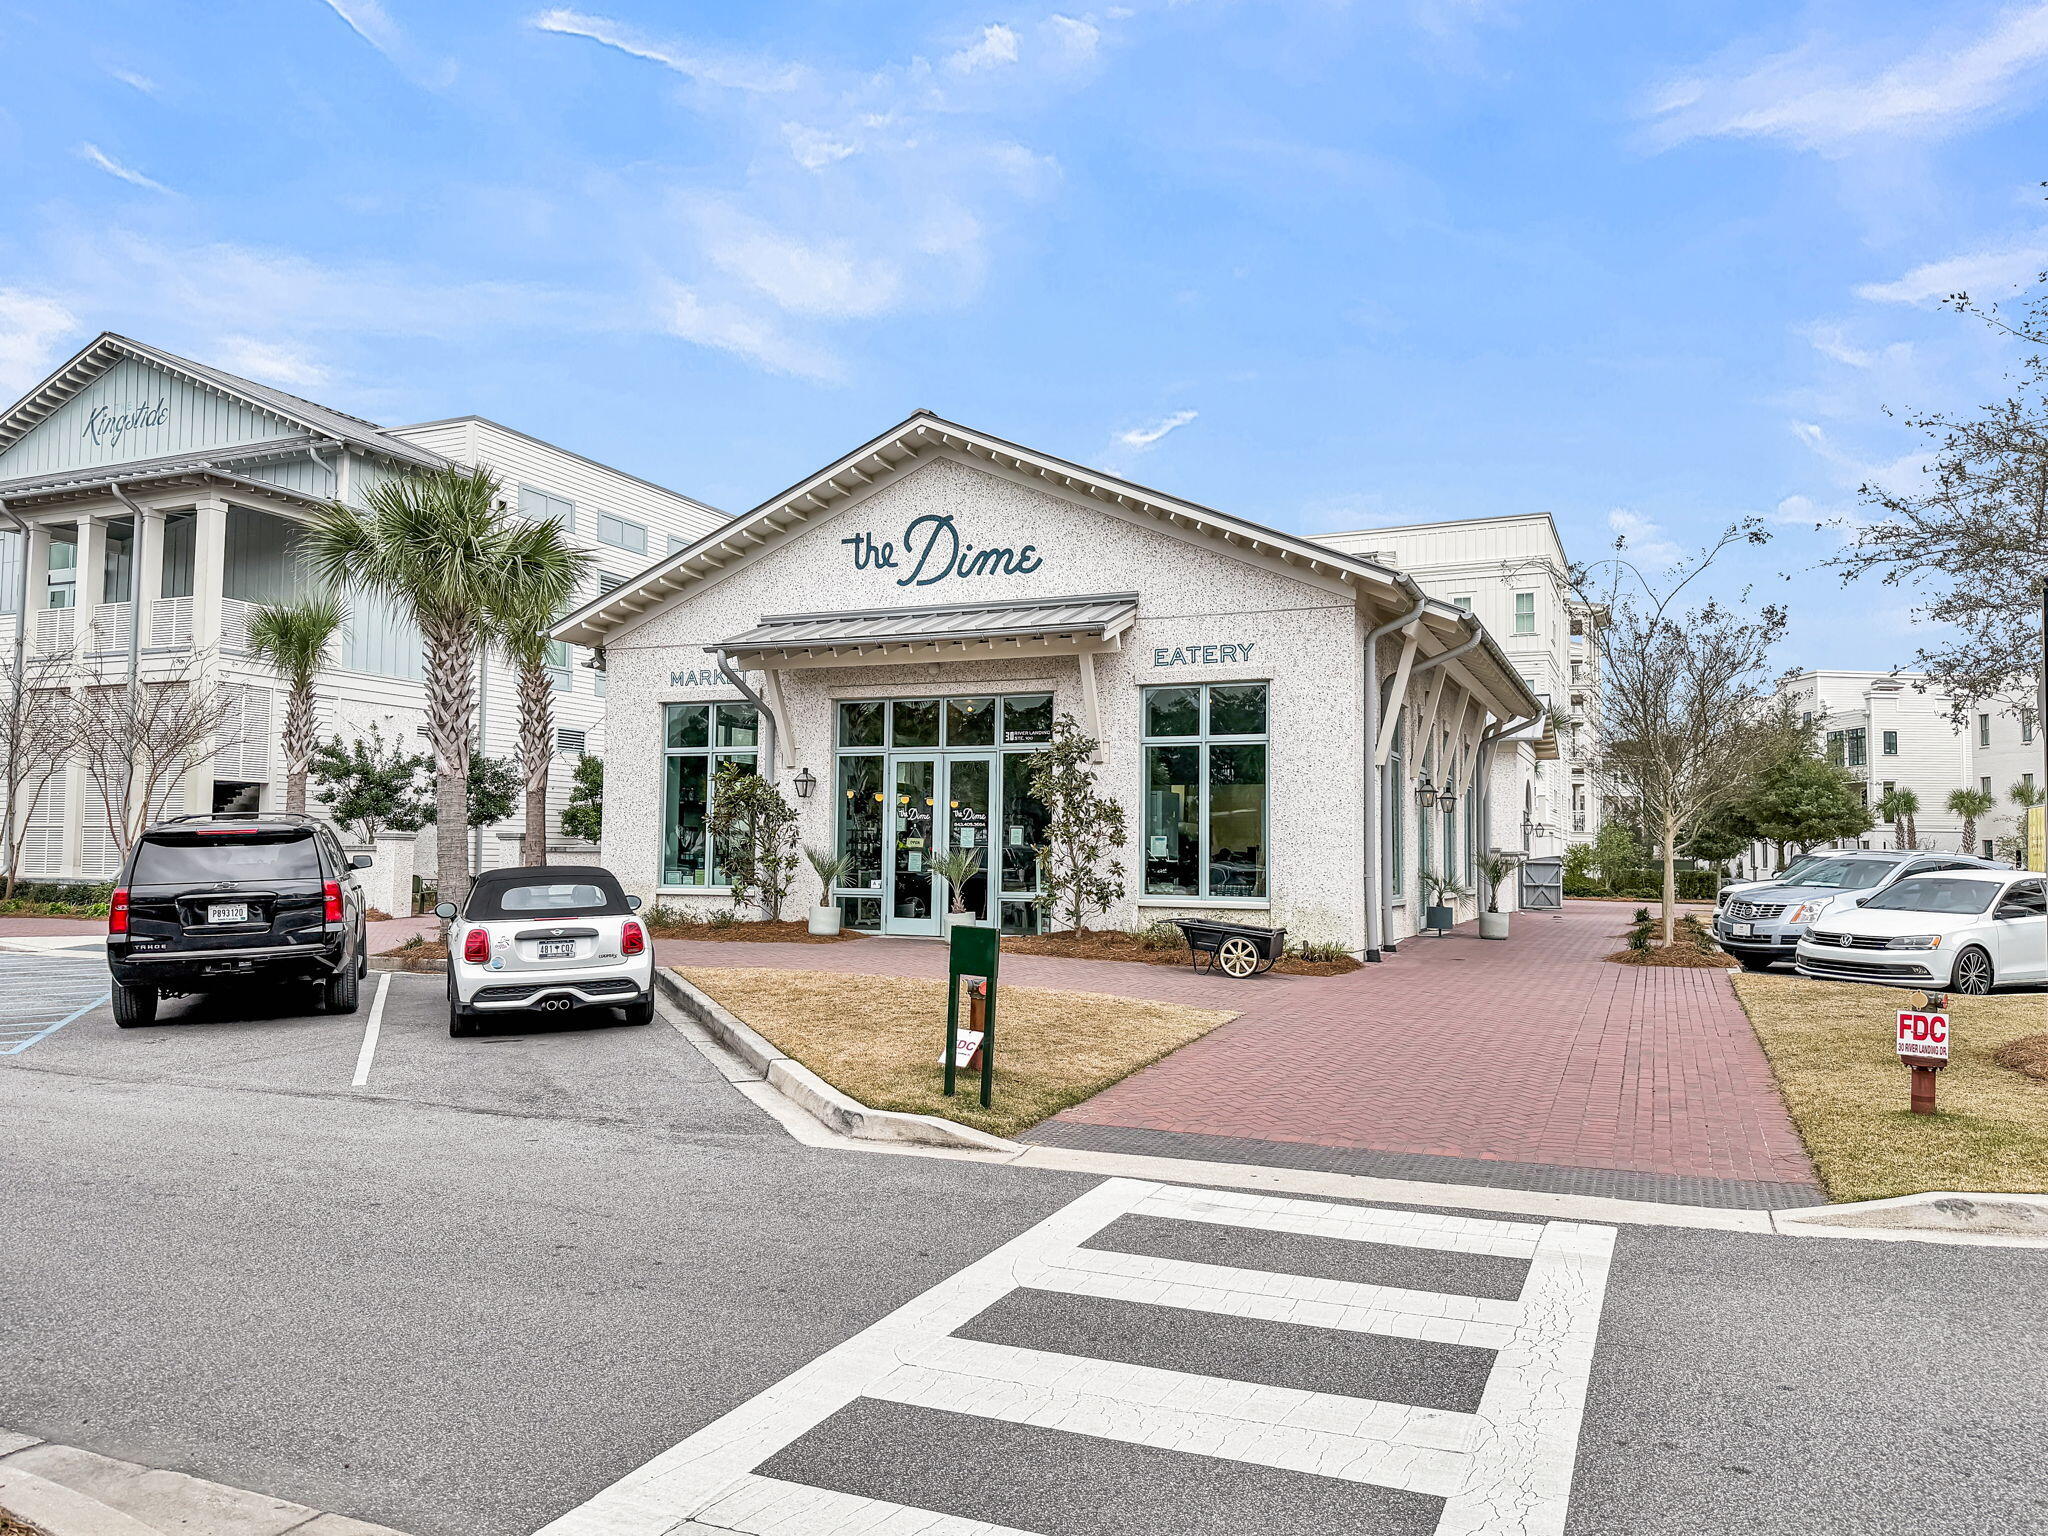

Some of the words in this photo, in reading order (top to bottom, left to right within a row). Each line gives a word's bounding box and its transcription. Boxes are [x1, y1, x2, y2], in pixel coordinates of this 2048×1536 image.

[82, 398, 168, 447] Kingstide
[841, 532, 898, 570] the
[896, 514, 1043, 586] Dime
[1154, 643, 1255, 666] EATERY
[1005, 731, 1014, 741] 30
[907, 808, 930, 820] Dime
[962, 808, 986, 821] Dime
[212, 908, 244, 917] P893120
[1899, 1014, 1946, 1043] FDC
[957, 1040, 976, 1051] DC
[1898, 1043, 1904, 1051] 30
[1905, 1043, 1918, 1053] RIVER
[1919, 1045, 1938, 1055] LANDING
